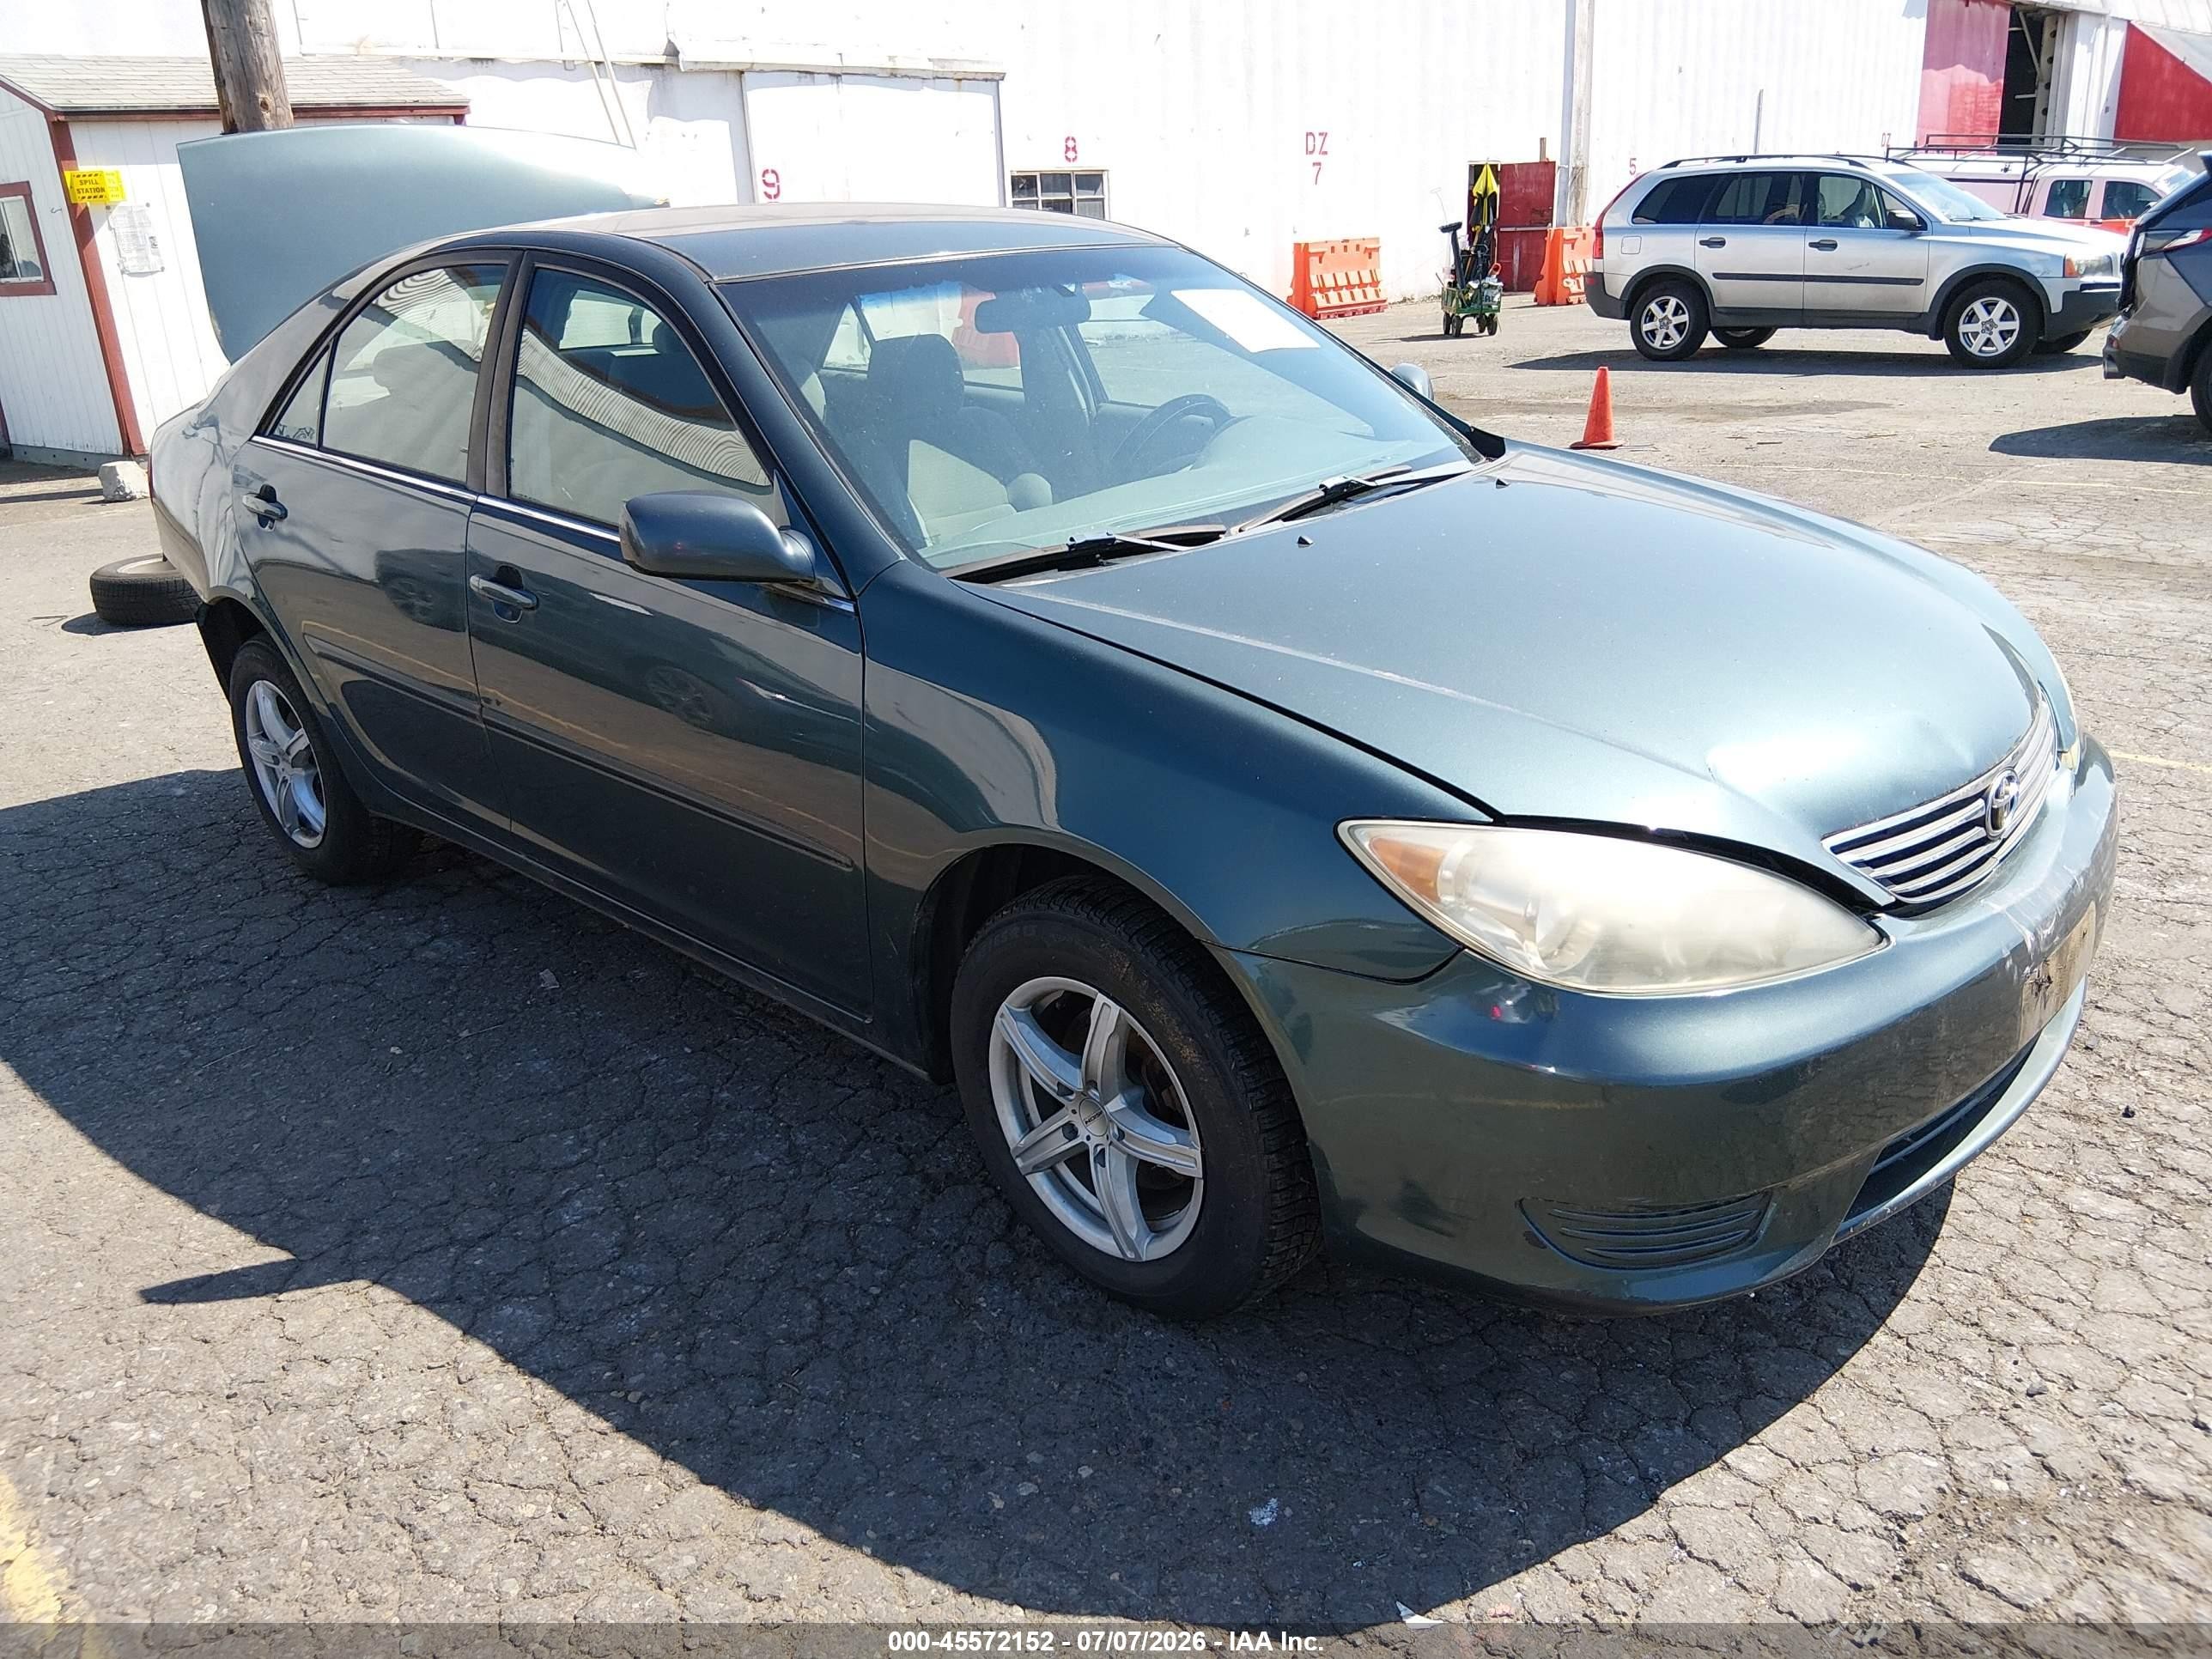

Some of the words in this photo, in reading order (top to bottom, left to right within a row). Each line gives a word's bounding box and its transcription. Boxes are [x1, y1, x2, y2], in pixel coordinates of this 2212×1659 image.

[1064, 136, 1078, 162] 8
[1305, 131, 1328, 155] DZ
[1312, 161, 1322, 185] 7
[1629, 157, 1637, 176] 5
[763, 169, 780, 199] 9
